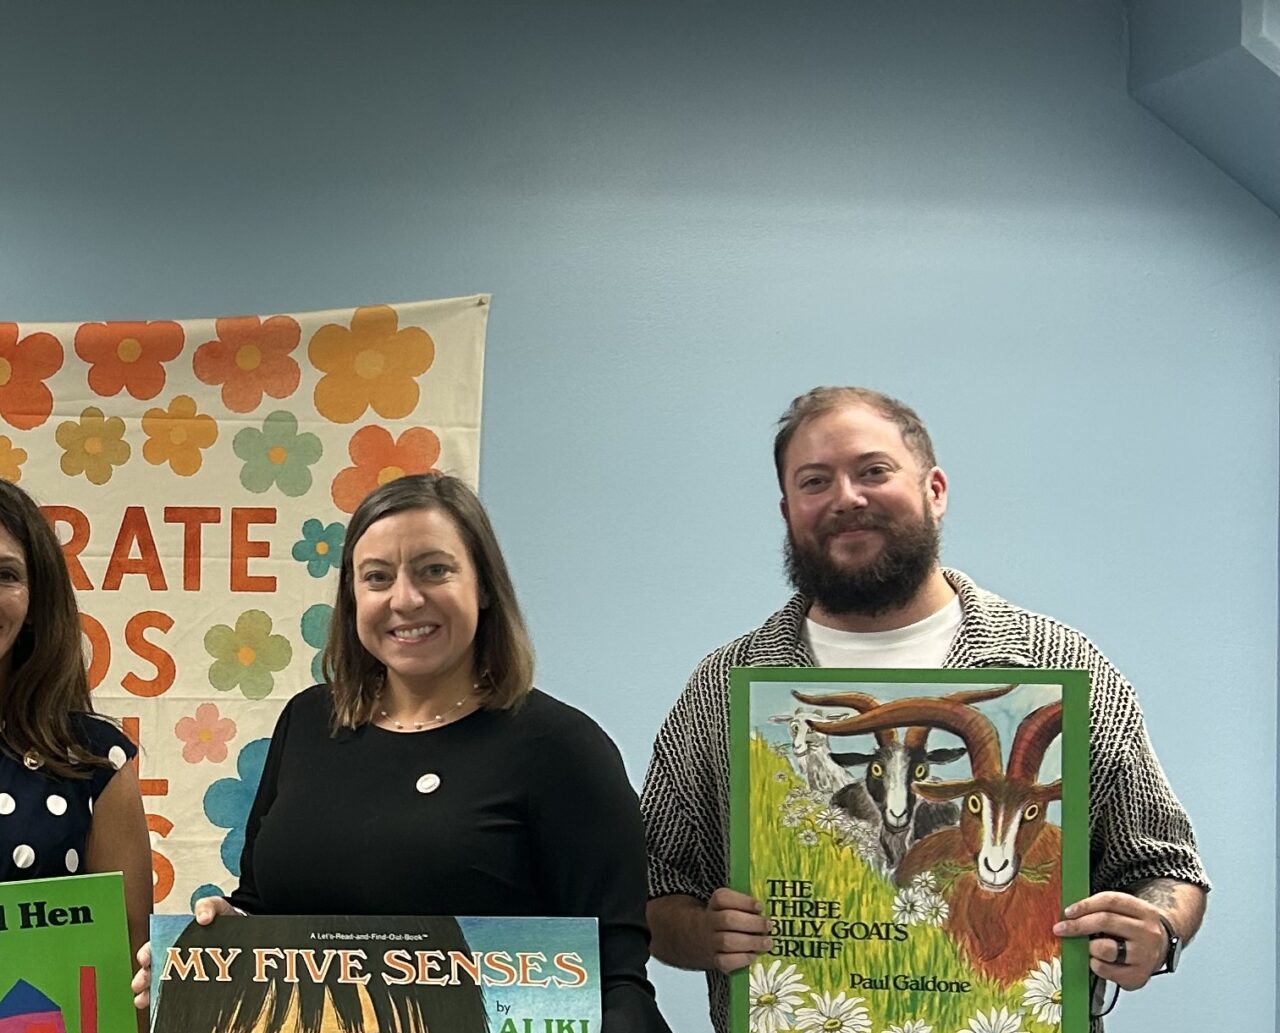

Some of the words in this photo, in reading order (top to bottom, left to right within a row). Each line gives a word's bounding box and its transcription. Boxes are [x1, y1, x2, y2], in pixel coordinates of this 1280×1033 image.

[766, 879, 813, 899] THE
[18, 901, 94, 929] Hen
[766, 899, 841, 919] THREE
[769, 920, 825, 938] BILLY
[831, 921, 909, 942] GOATS
[769, 938, 843, 959] GRUFF
[159, 947, 242, 982] MY
[252, 948, 371, 986] FIVE
[381, 949, 588, 988] SENSES
[849, 973, 890, 991] Paul
[893, 974, 971, 993] Galdone
[496, 1001, 511, 1015] by
